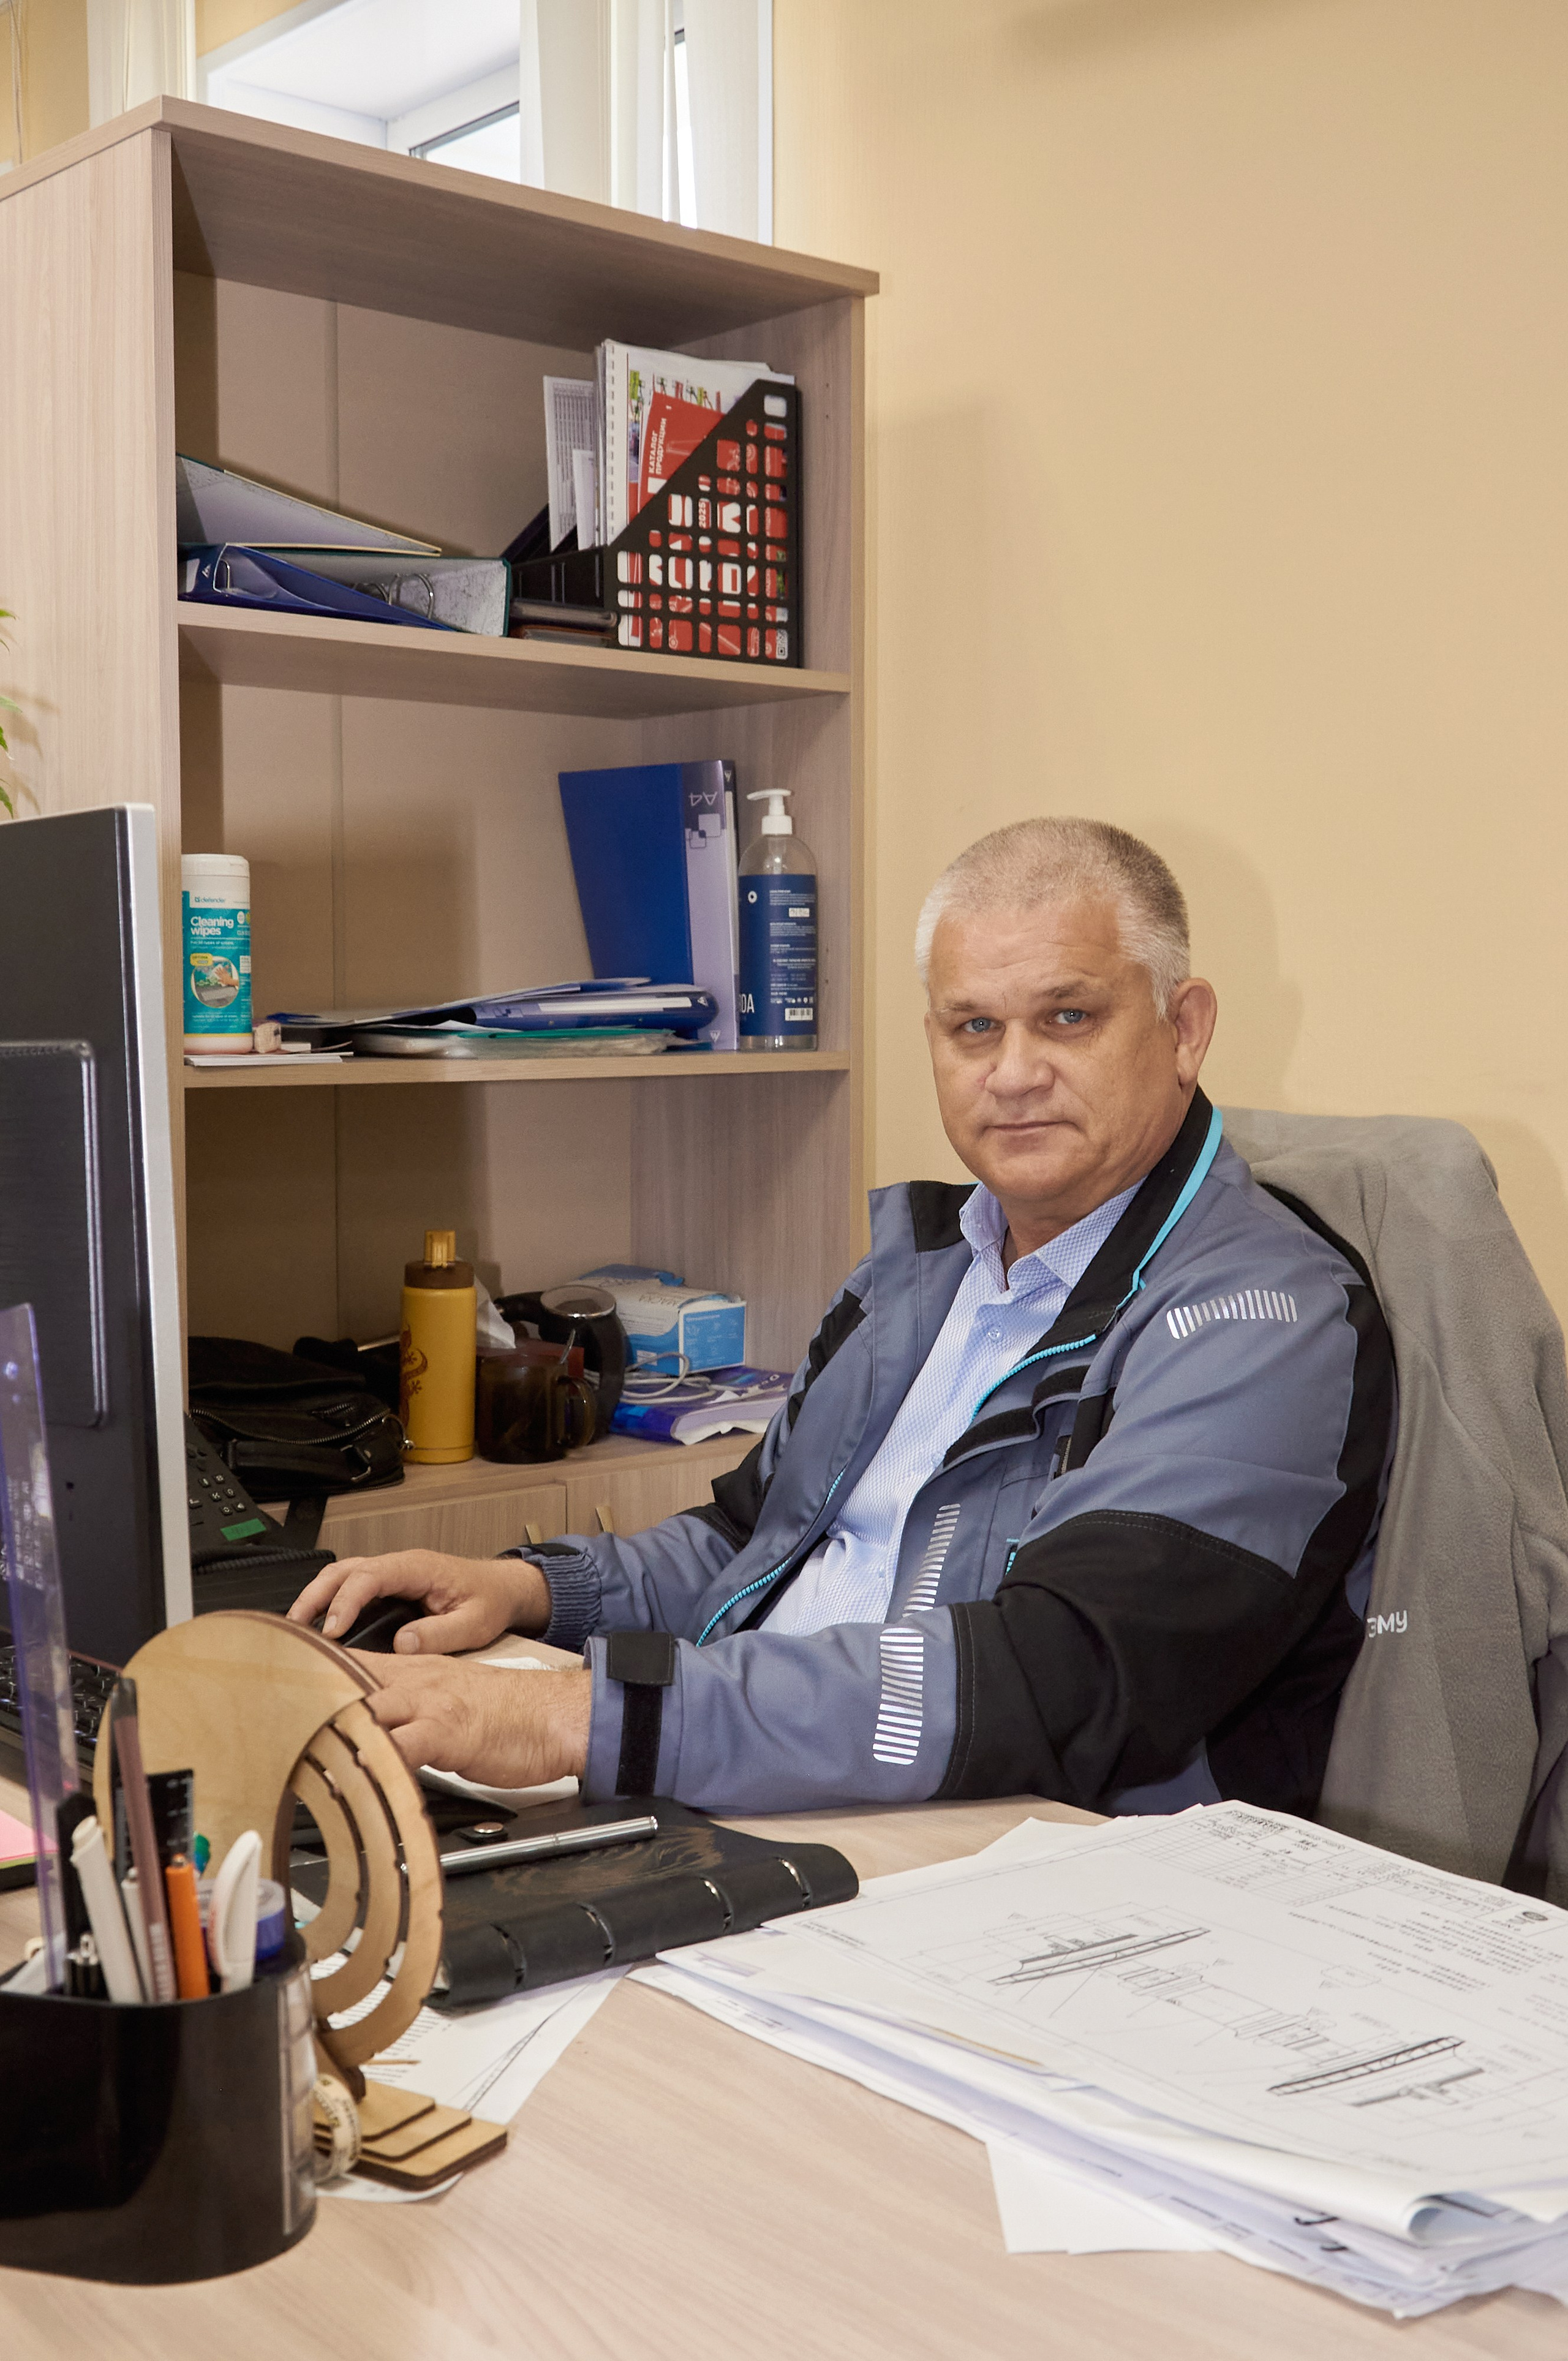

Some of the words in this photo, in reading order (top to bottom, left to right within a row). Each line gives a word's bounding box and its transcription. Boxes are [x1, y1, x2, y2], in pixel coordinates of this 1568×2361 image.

[648, 429, 658, 474] КАТАЛОГ
[655, 418, 667, 475] ПРОДУКЦИИ
[688, 791, 718, 806] A4
[190, 916, 234, 929] Cleaning
[190, 926, 221, 937] wipes
